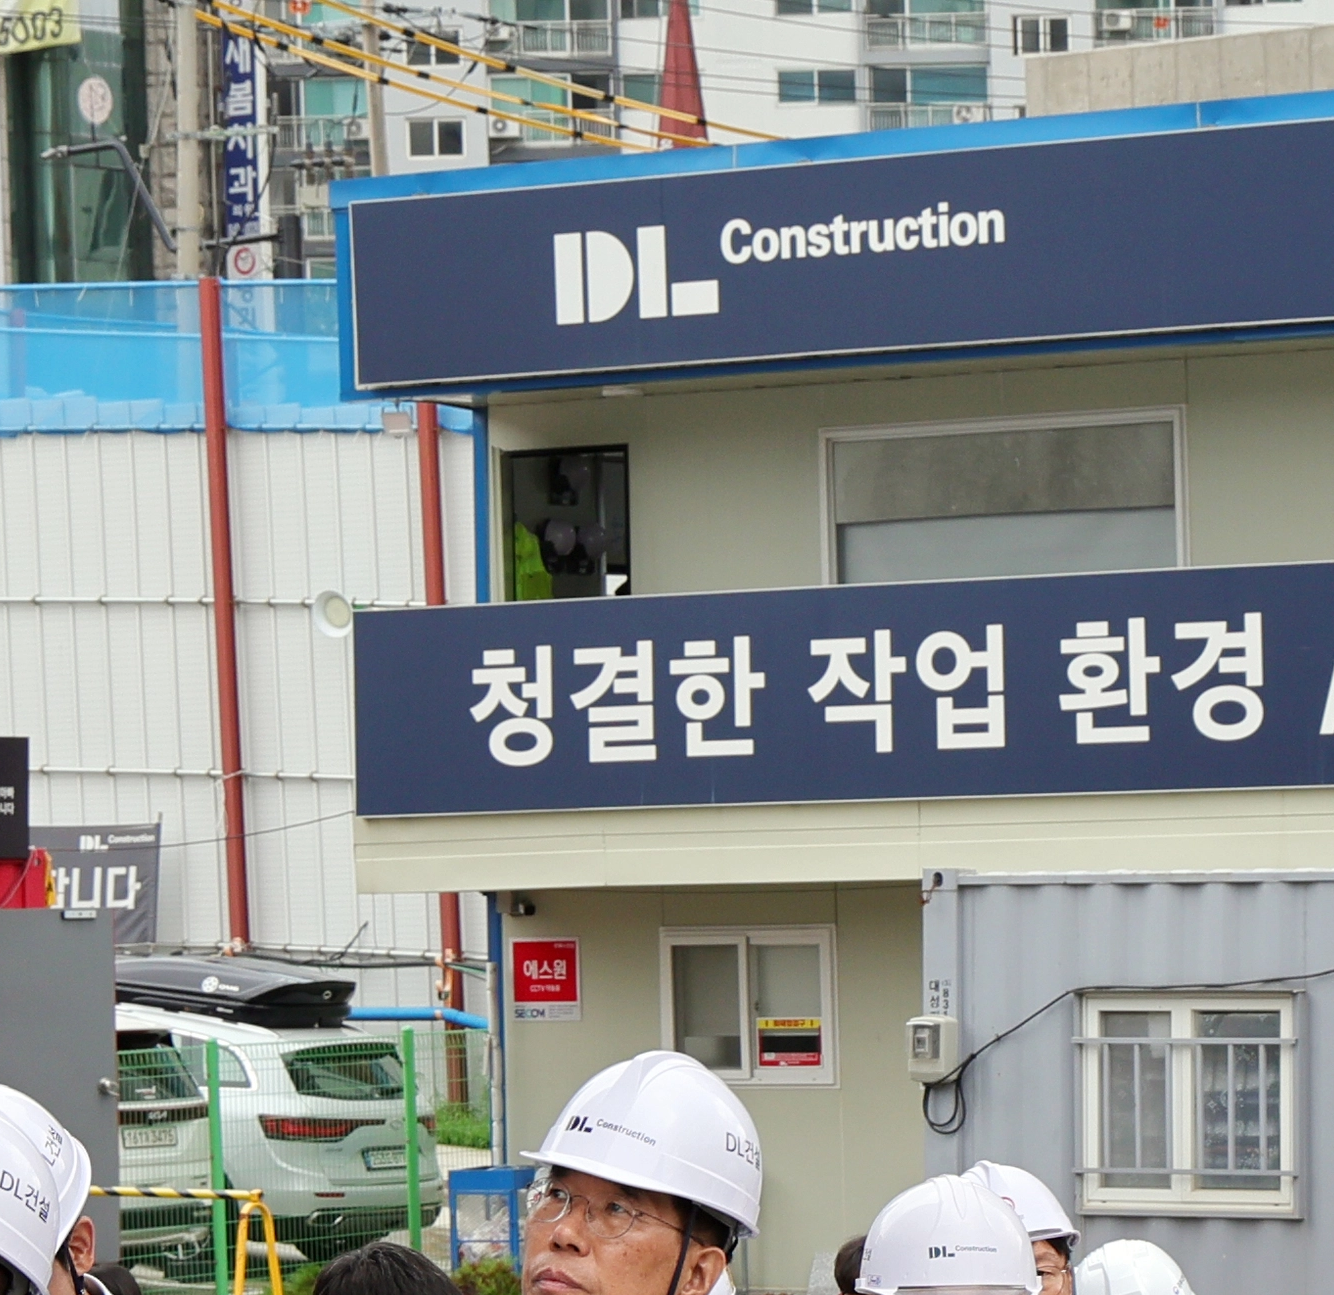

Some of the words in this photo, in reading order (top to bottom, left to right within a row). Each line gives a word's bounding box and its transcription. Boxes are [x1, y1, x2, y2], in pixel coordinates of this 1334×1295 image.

[554, 225, 719, 325] DL
[720, 201, 1005, 264] Construction
[469, 635, 766, 767] 청결한
[807, 623, 1007, 753] 작업
[1058, 611, 1265, 745] 환경
[79, 835, 109, 851] DL
[108, 833, 156, 844] Construction
[523, 959, 567, 980] 에스원
[565, 1115, 594, 1133] DL
[596, 1118, 657, 1147] Construction
[928, 1245, 956, 1259] DL
[955, 1245, 998, 1253] Construction
